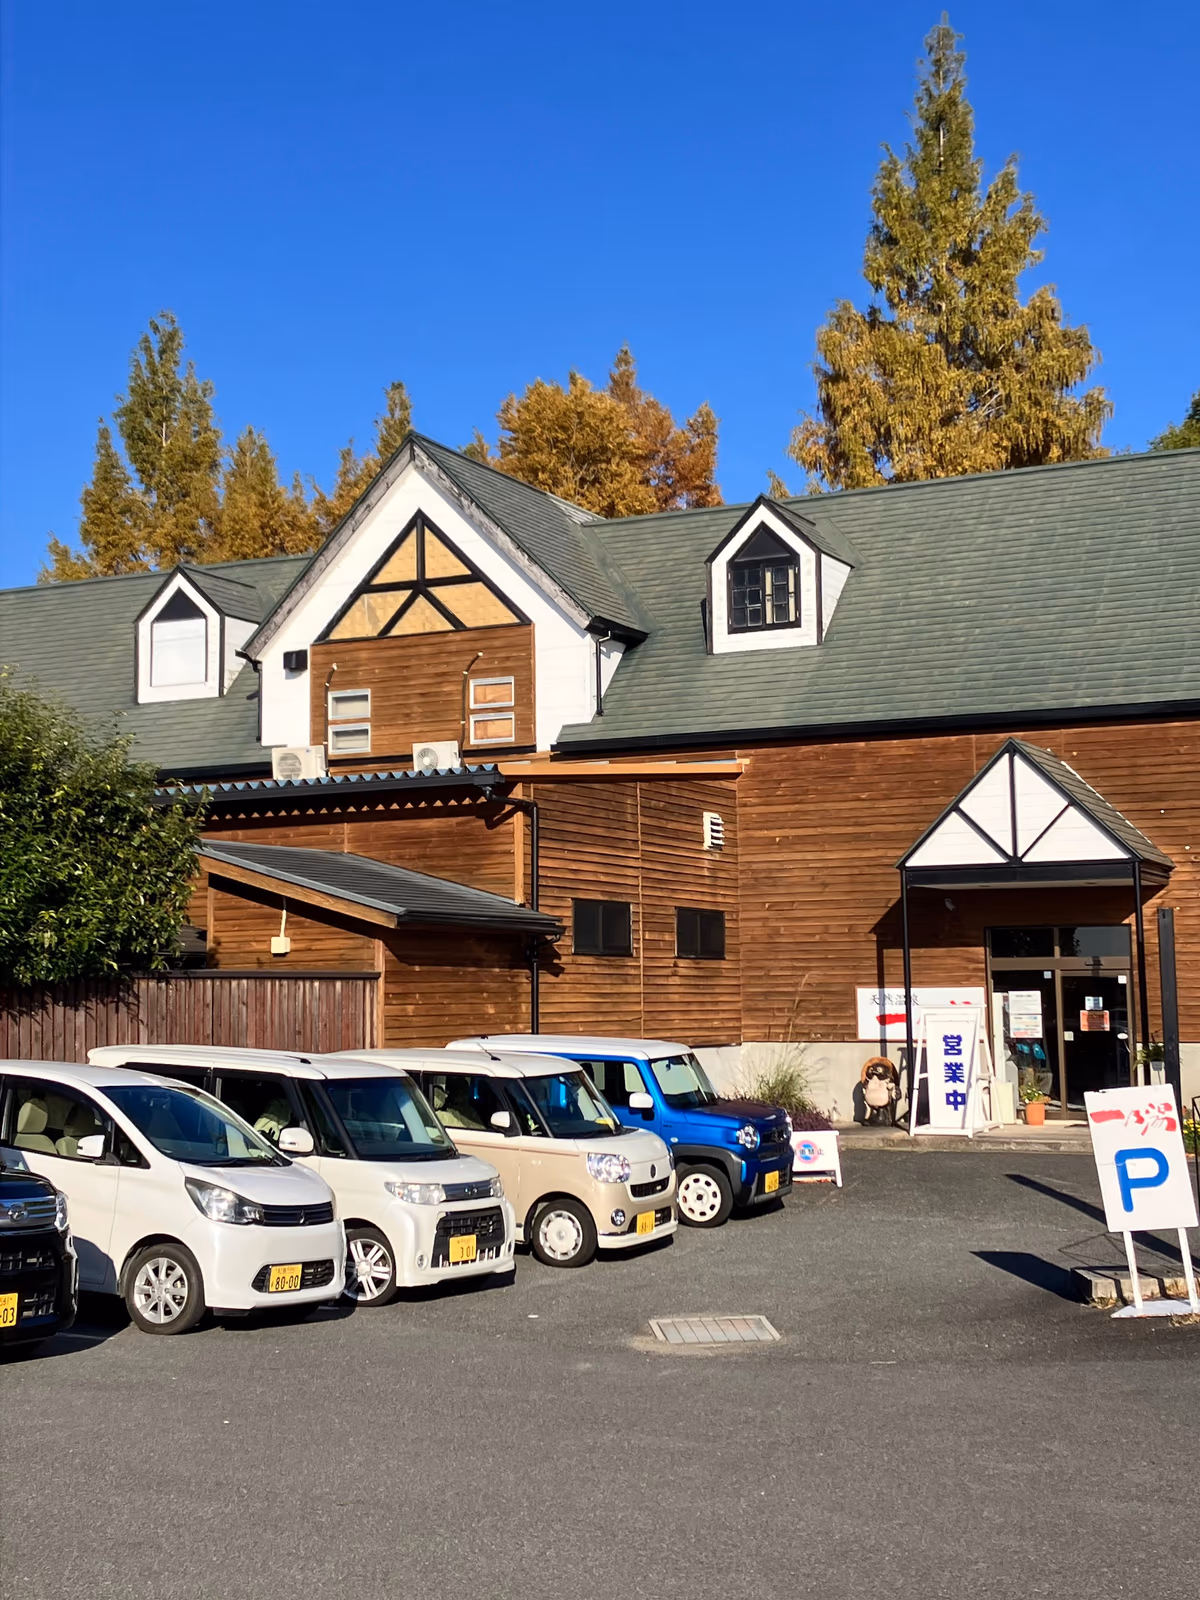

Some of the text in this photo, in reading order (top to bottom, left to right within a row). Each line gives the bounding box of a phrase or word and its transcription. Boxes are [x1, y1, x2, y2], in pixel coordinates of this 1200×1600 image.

[942, 1034, 965, 1111] 営業中
[1114, 1147, 1170, 1213] P
[275, 1274, 299, 1290] 80-00
